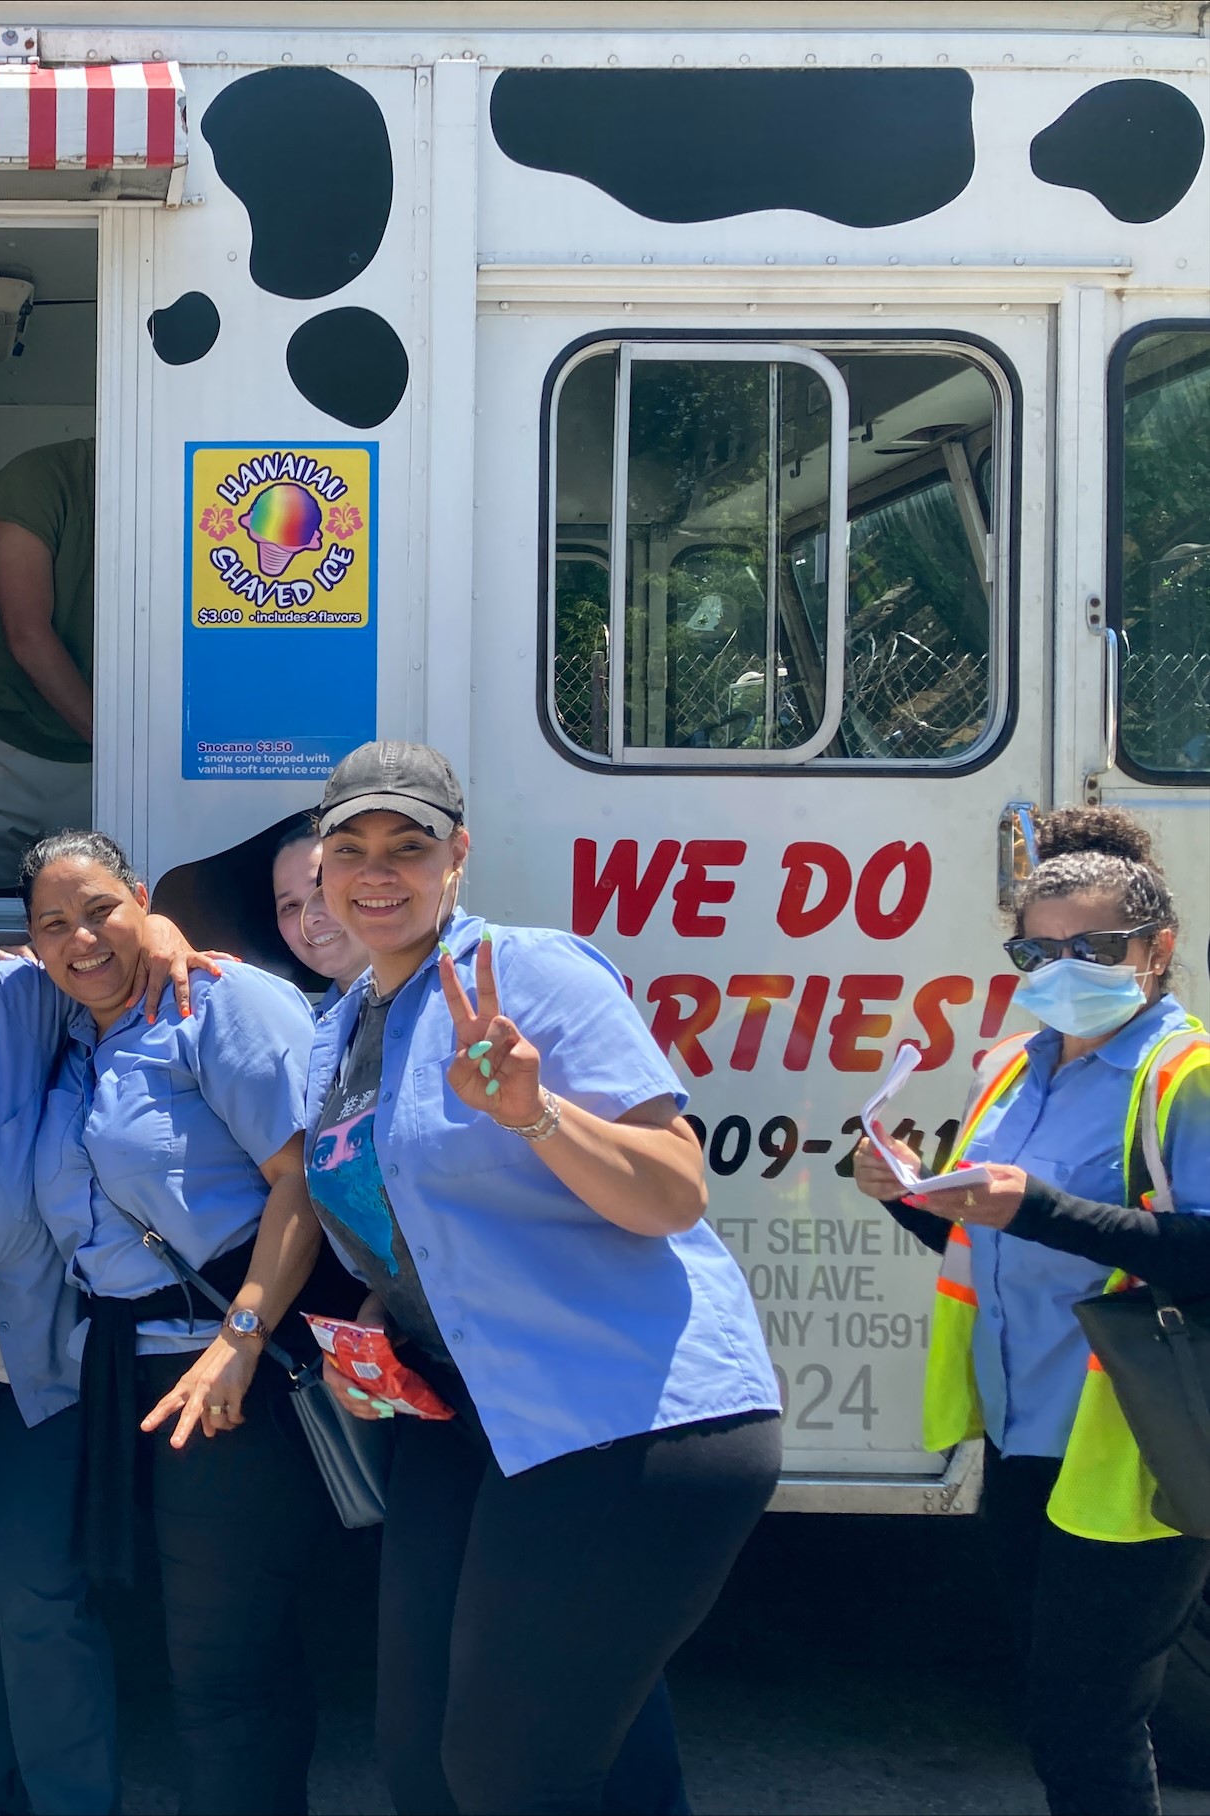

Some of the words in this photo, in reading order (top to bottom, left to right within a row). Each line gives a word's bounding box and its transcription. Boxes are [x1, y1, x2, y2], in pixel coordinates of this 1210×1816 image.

[216, 451, 348, 506] HAWAIIAN
[210, 546, 315, 608] SHAVED
[313, 543, 354, 592] ICE
[198, 608, 243, 624] $3.00
[256, 611, 311, 623] includes
[309, 612, 317, 623] 2
[317, 611, 361, 623] flavors
[197, 742, 253, 753] Snocano
[257, 741, 293, 754] $3.50
[204, 755, 232, 763] snow
[235, 755, 261, 763] cone
[264, 754, 304, 765] topped
[306, 753, 330, 763] with
[198, 765, 233, 774] vanilla
[236, 765, 257, 774] soft
[292, 765, 308, 774] ice
[571, 837, 747, 938] WE
[776, 840, 932, 940] DO
[624, 974, 1021, 1078] RTIES!
[706, 1218, 758, 1255] FT
[768, 1218, 882, 1256] SERVE
[739, 1264, 799, 1301] ON
[809, 1266, 884, 1302] AVE.
[766, 1311, 813, 1347] NY
[828, 1312, 929, 1349] 10591
